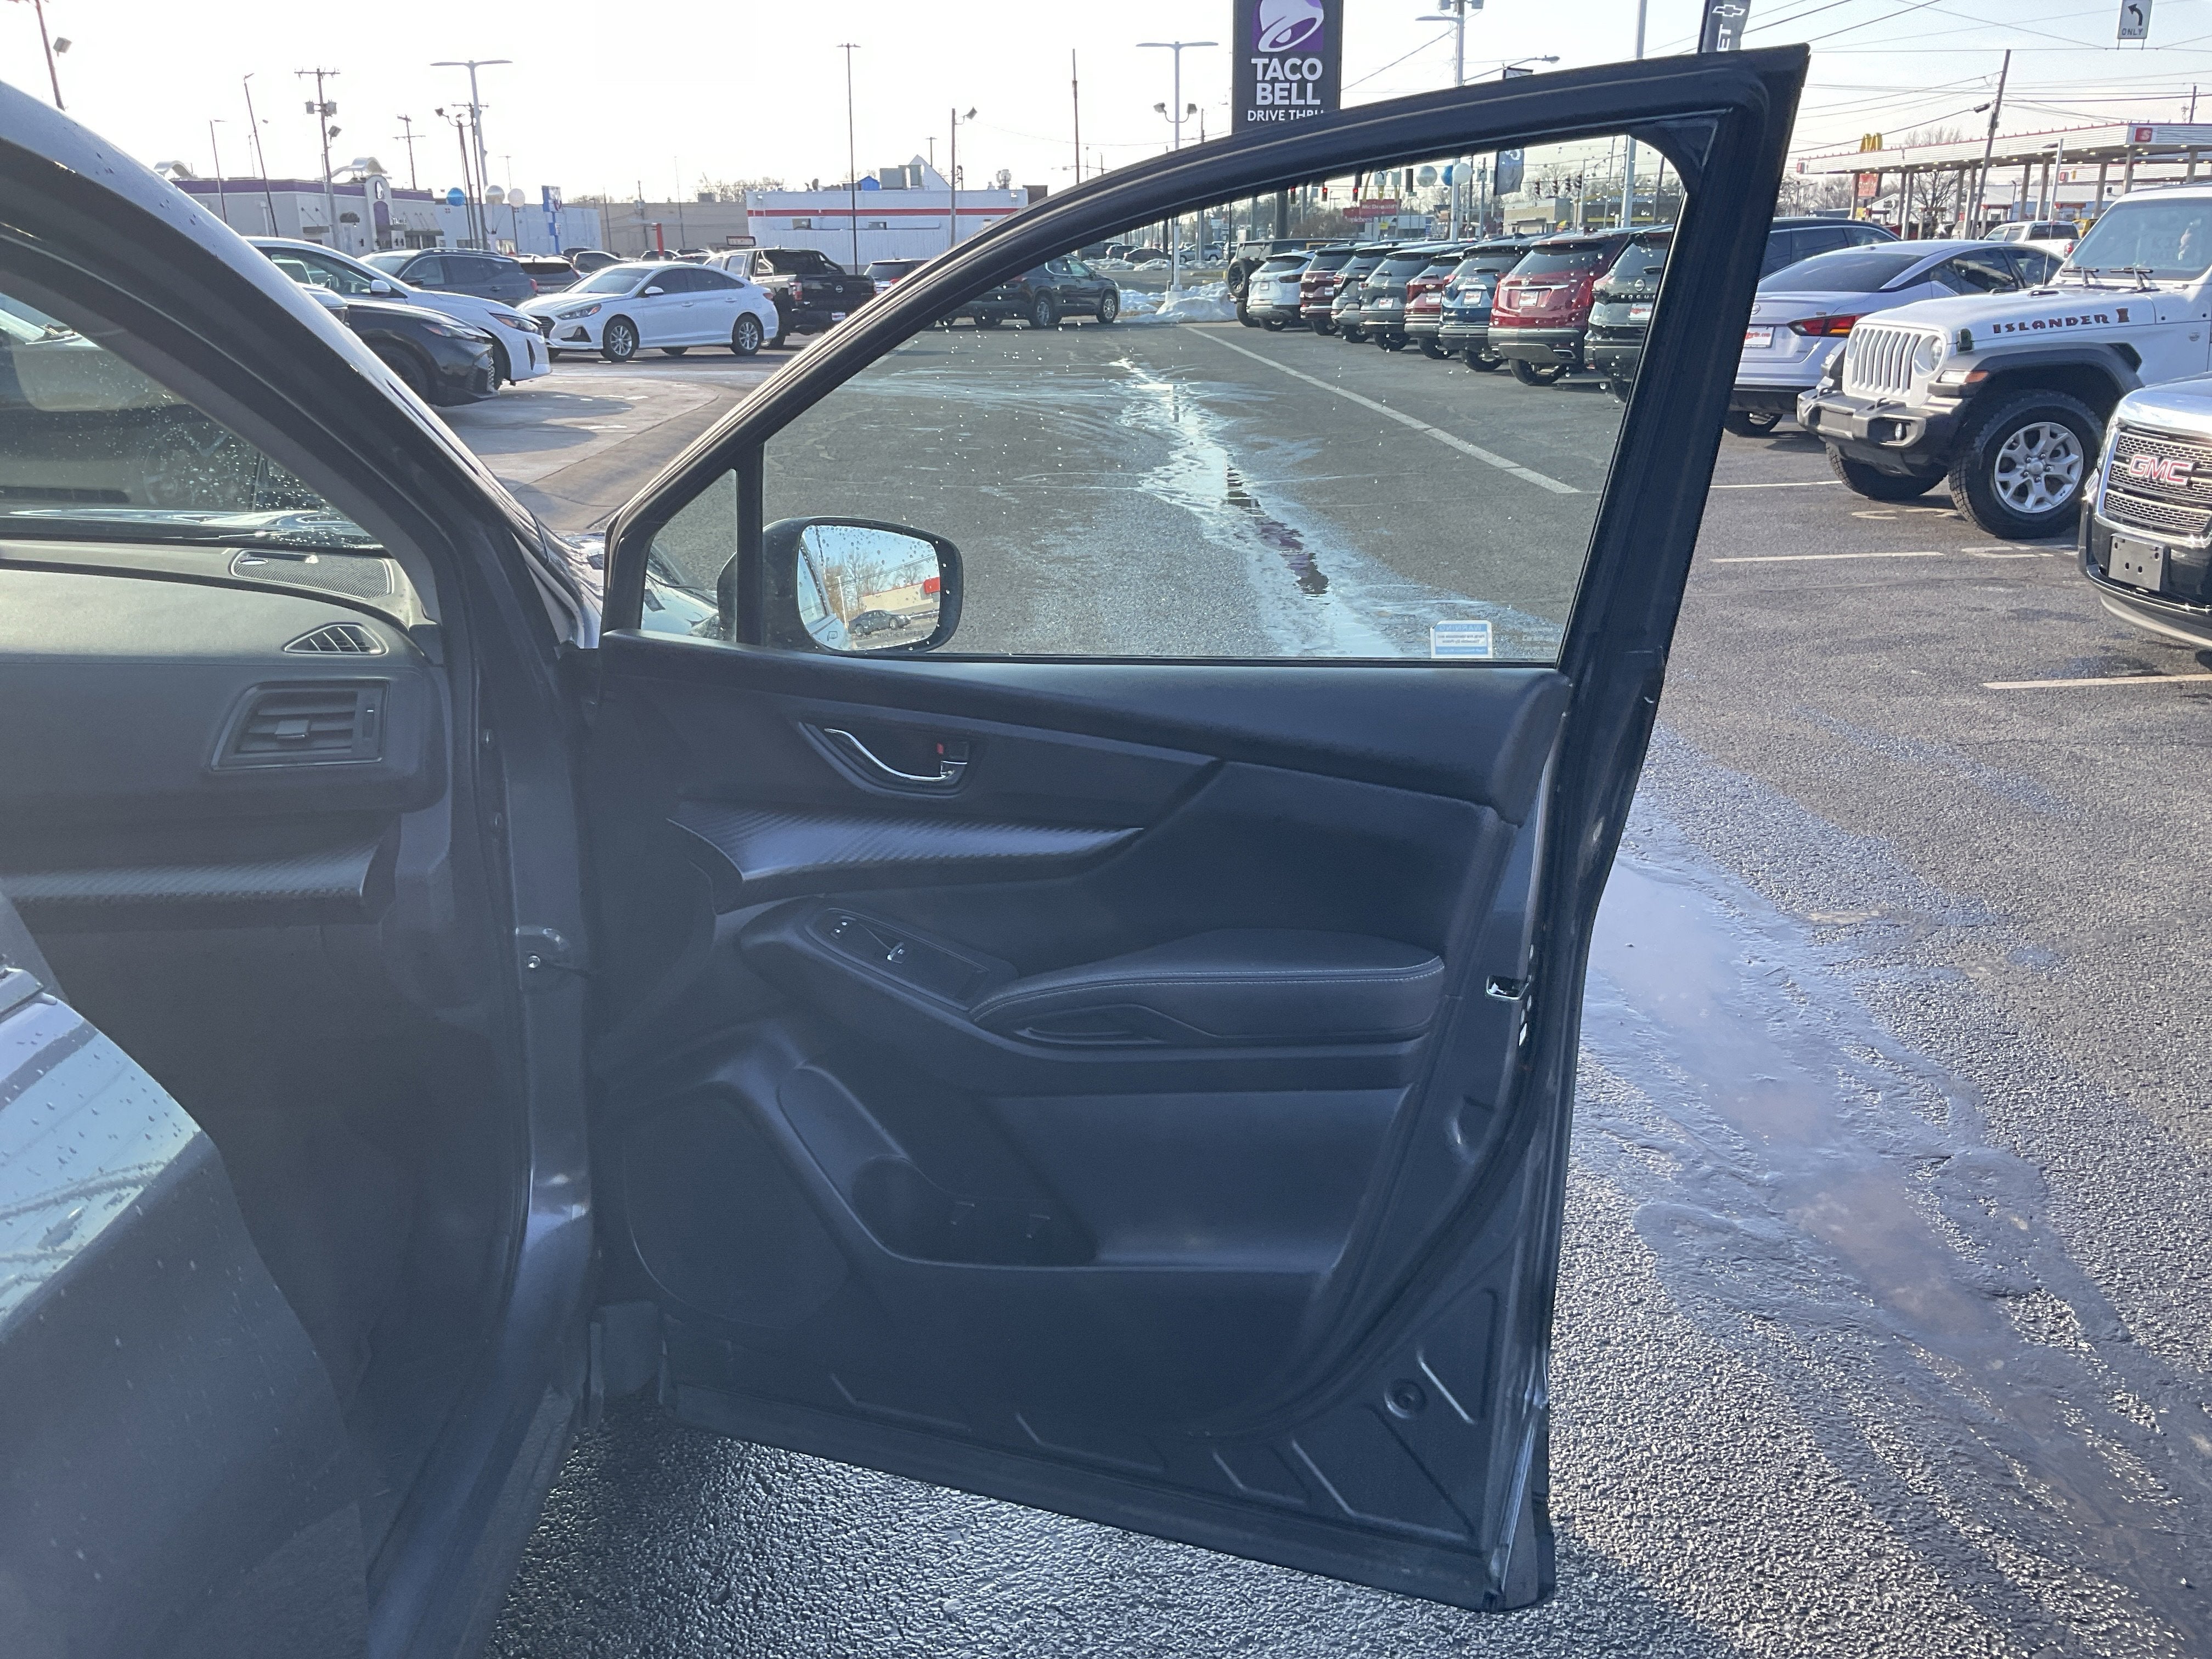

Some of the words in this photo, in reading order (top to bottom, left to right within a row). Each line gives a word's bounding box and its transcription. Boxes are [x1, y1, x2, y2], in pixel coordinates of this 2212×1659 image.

[1251, 58, 1323, 81] TACO
[1256, 83, 1321, 105] BELL
[1248, 110, 1285, 122] DRIVE
[1993, 313, 2110, 334] ISLANDER
[2129, 453, 2194, 486] GMC
